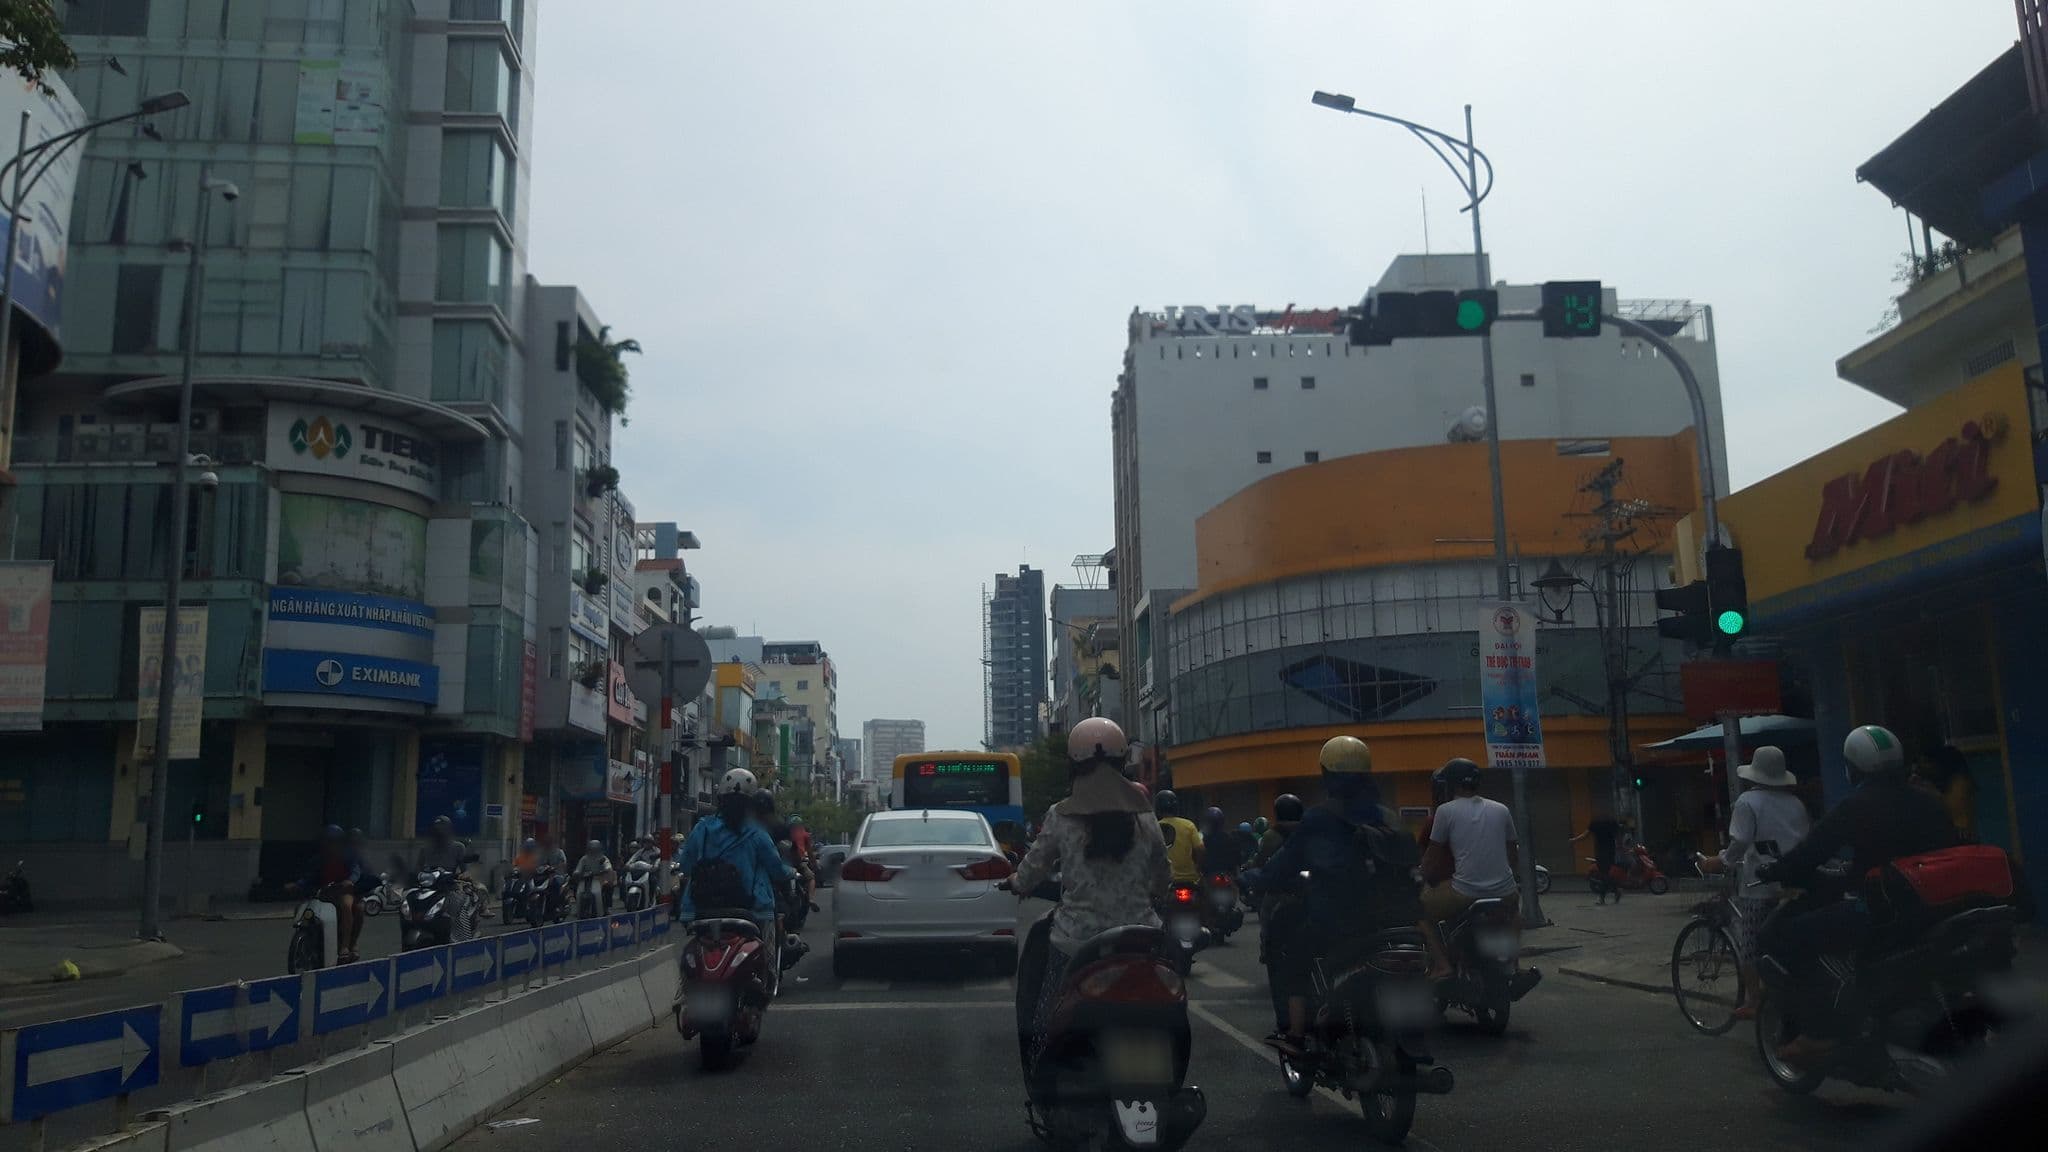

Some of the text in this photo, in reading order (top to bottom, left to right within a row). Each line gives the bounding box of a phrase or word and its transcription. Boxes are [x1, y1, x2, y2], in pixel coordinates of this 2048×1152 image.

[1164, 304, 1257, 335] IRIS
[272, 597, 303, 614] NGÂN
[305, 597, 335, 616] HÀNG
[338, 600, 363, 618] XUẤT
[366, 606, 390, 623] NHẬP
[352, 667, 421, 688] EXIMBANK
